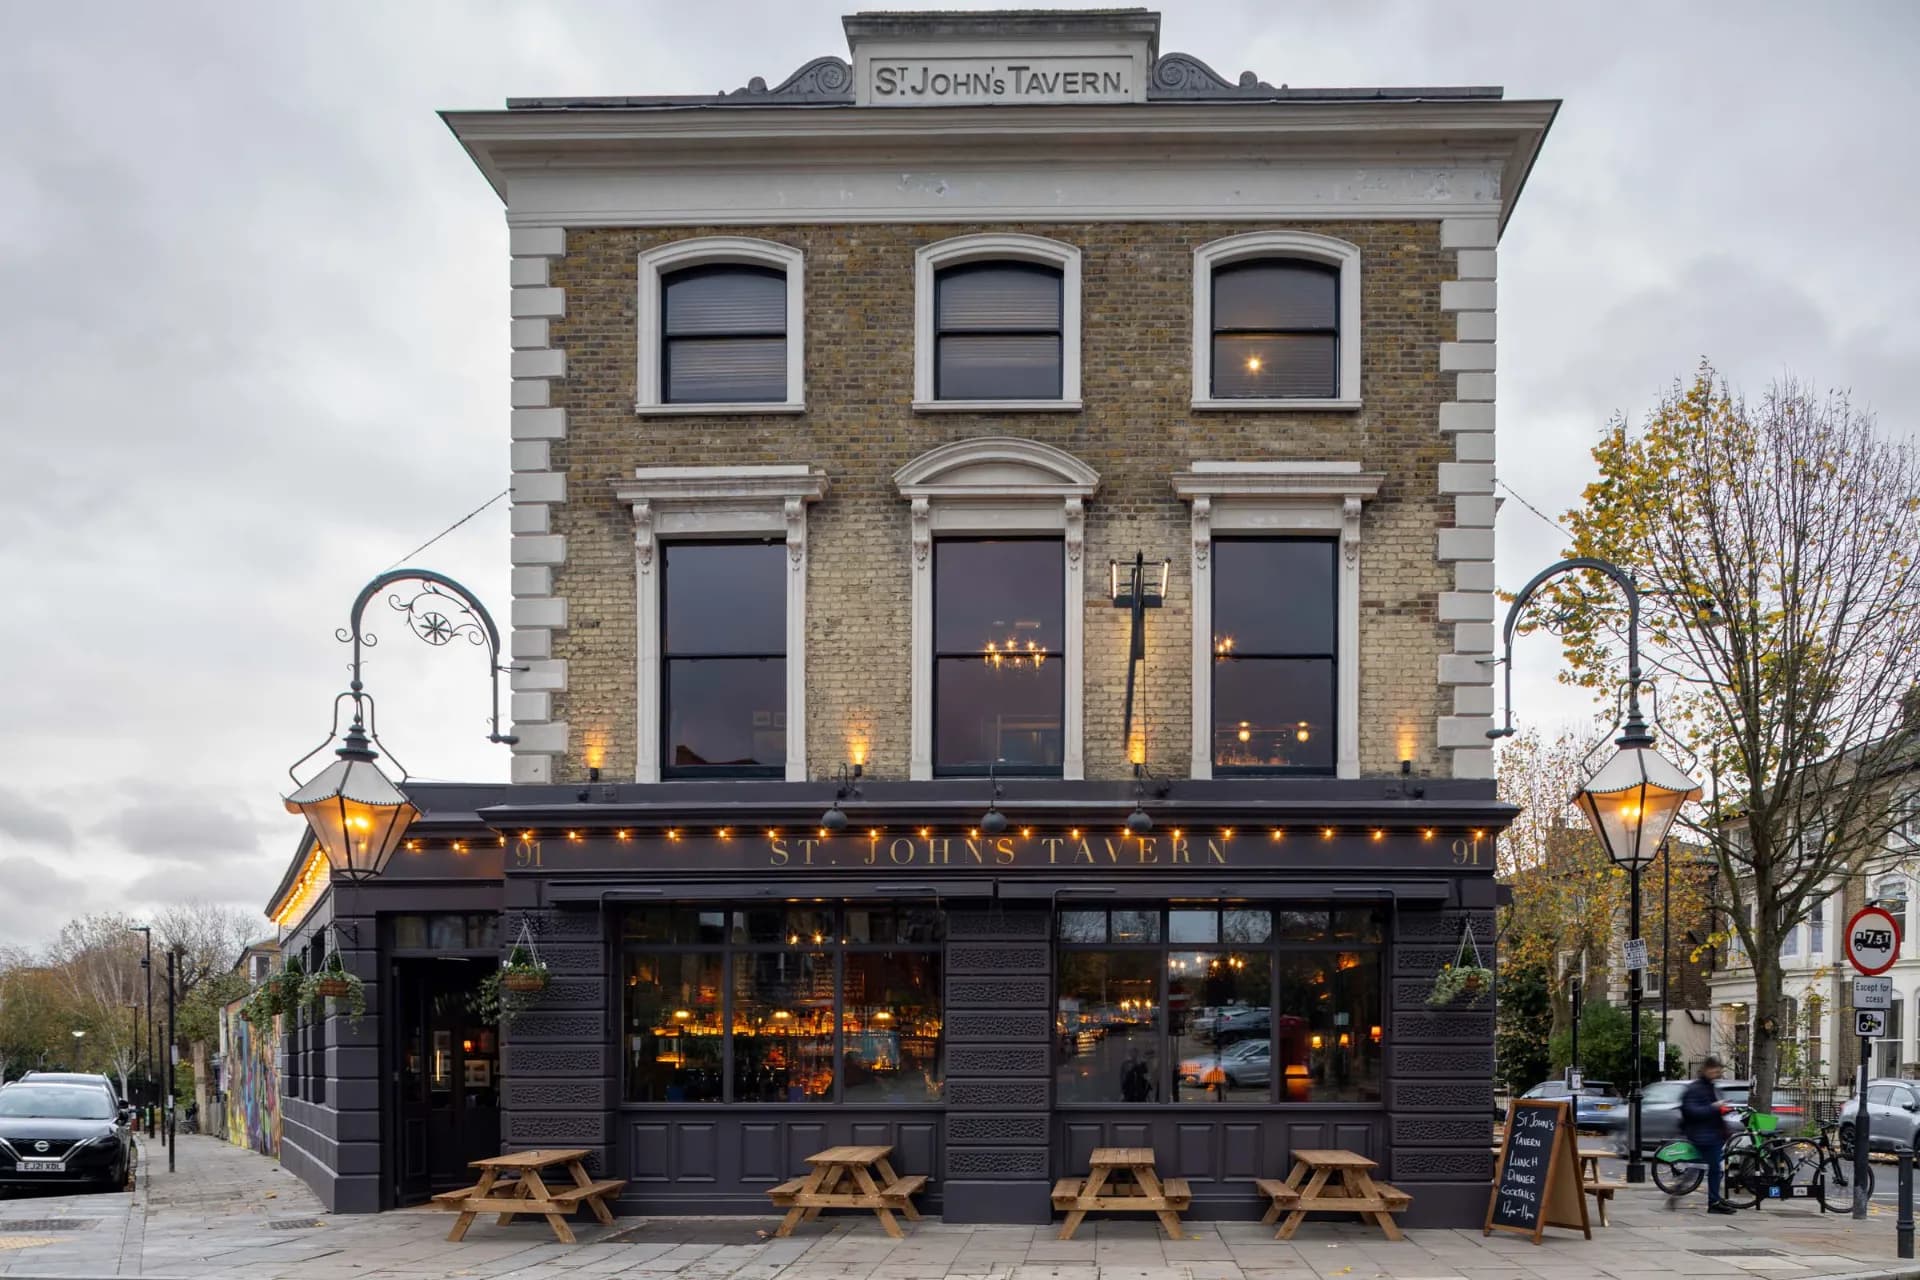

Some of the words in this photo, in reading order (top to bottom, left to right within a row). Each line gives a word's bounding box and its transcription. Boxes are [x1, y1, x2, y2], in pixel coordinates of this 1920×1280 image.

[515, 841, 544, 867] 91
[770, 839, 836, 866] ST.
[864, 838, 1015, 865] JOHN'S
[1041, 837, 1230, 864] TAVERN
[1451, 839, 1480, 865] 91
[1856, 982, 1878, 993] Except
[1880, 983, 1889, 992] for
